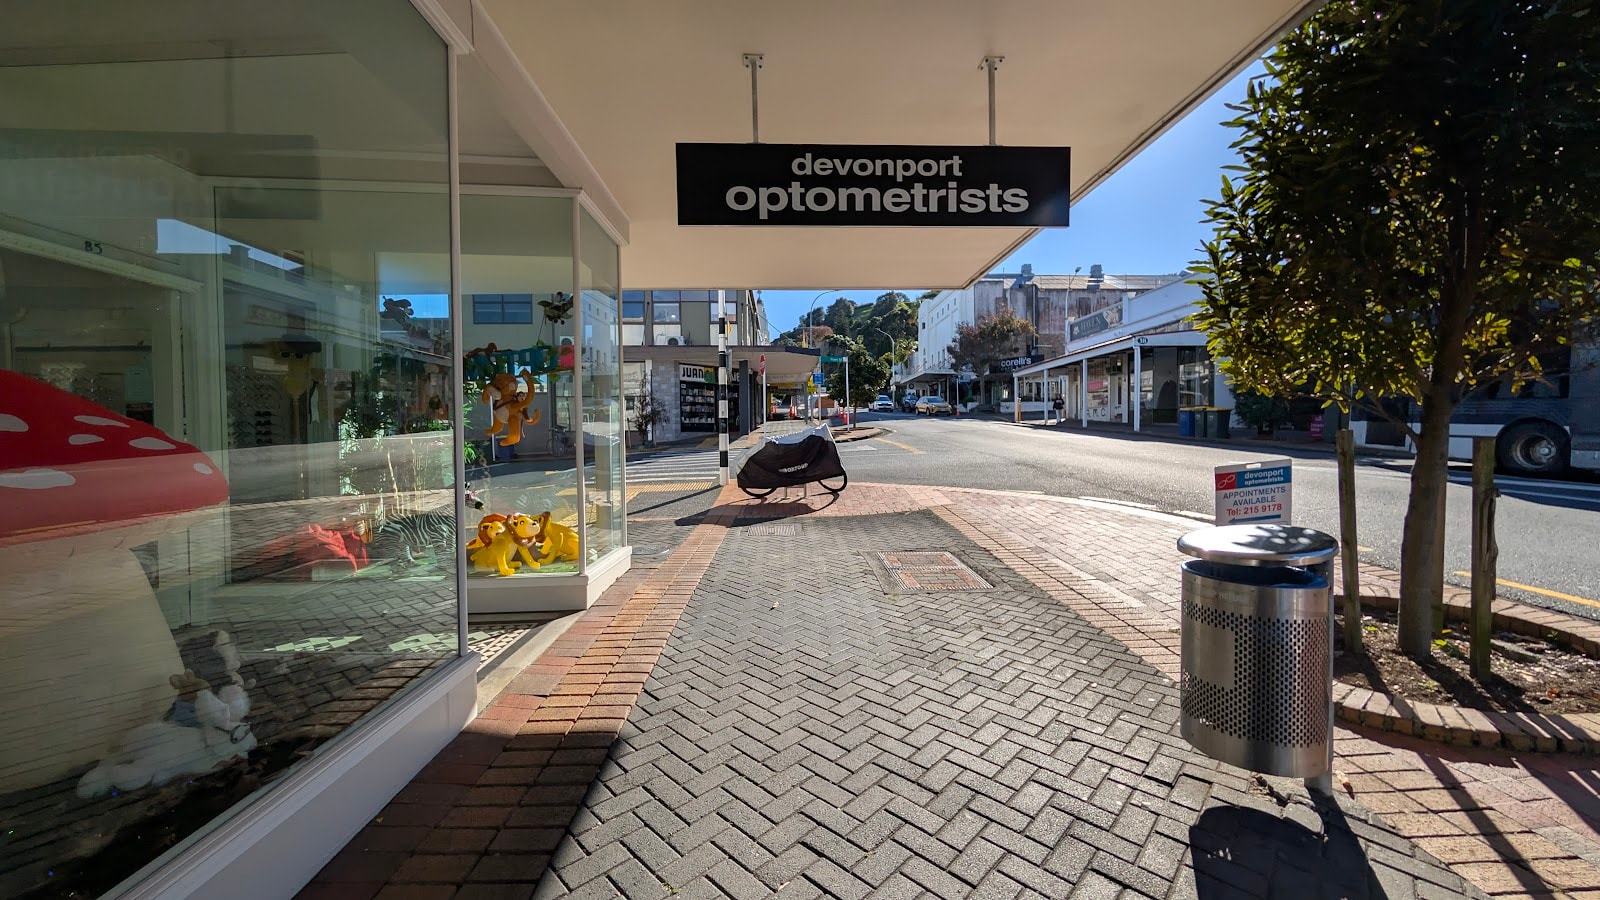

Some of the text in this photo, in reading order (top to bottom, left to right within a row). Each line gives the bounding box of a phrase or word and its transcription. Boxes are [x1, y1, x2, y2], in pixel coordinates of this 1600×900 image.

[791, 152, 963, 182] devonport
[725, 181, 1030, 220] optometrists
[682, 367, 704, 379] JUAN
[1244, 468, 1283, 479] devonport
[1244, 476, 1284, 486] optometrists
[1223, 486, 1286, 500] APPOINTMENTS
[1232, 495, 1276, 507] AVAILABLE
[1227, 503, 1282, 517] Tel: 215 9178
